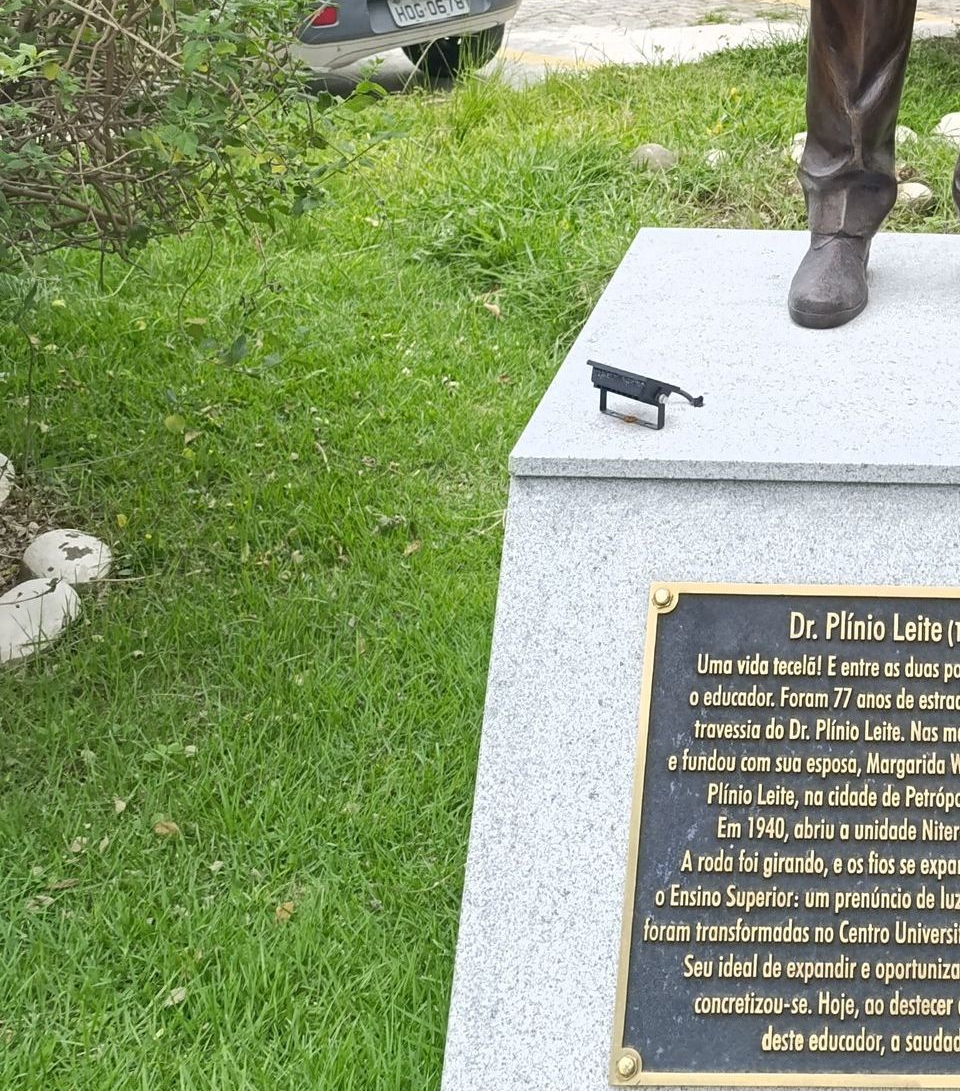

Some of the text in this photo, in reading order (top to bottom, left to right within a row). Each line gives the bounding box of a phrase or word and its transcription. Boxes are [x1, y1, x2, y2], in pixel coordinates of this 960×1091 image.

[790, 611, 818, 639] Dr.
[826, 610, 885, 641] Plínio
[893, 613, 942, 642] Leite
[697, 653, 733, 674] Uma
[737, 653, 769, 675] vida
[773, 654, 822, 676] tecelã!
[827, 655, 836, 676] E
[841, 658, 880, 677] entre
[884, 662, 900, 677] as
[905, 655, 939, 678] duas
[689, 691, 699, 706] o
[703, 684, 775, 707] educador.
[780, 686, 828, 708] Foram
[833, 687, 852, 708] 77
[856, 692, 892, 709] anos
[896, 687, 914, 709] de
[694, 720, 761, 739] travessia
[765, 717, 784, 739] do
[789, 718, 810, 740] Dr.
[816, 718, 859, 741] Plínio
[864, 719, 905, 741] Leite.
[910, 720, 938, 742] Nas
[668, 755, 677, 771] e
[682, 748, 736, 771] fundou
[740, 756, 771, 772] com
[775, 756, 802, 772] sua
[806, 757, 862, 778] esposa,
[866, 751, 945, 779] Margarida
[708, 782, 753, 805] Plínio
[757, 783, 799, 809] Leite,
[804, 790, 823, 806] na
[828, 784, 877, 806] cidade
[881, 784, 901, 807] de
[717, 815, 741, 838] Em
[748, 816, 789, 843] 1940,
[794, 816, 835, 839] abriu
[840, 824, 849, 840] a
[855, 817, 917, 840] unidade
[680, 849, 692, 871] A
[698, 850, 733, 872] roda
[738, 848, 759, 872] foi
[763, 849, 828, 878] girando,
[833, 857, 843, 873] e
[847, 858, 863, 873] os
[868, 850, 895, 874] fios
[900, 858, 915, 874] se
[655, 890, 665, 906] o
[670, 884, 721, 907] Ensino
[726, 884, 799, 912] Superior:
[805, 891, 829, 908] um
[835, 886, 912, 913] prenúncio
[916, 886, 935, 909] de
[644, 917, 690, 942] foram
[696, 917, 810, 943] transformadas
[815, 926, 834, 943] no
[839, 920, 890, 943] Centro
[683, 954, 713, 977] Seu
[718, 954, 758, 977] ideal
[762, 953, 782, 978] de
[786, 954, 857, 983] expandir
[861, 962, 870, 979] e
[694, 992, 812, 1014] concretizou-se.
[818, 991, 859, 1020] Hoje,
[865, 998, 884, 1015] ao
[889, 991, 954, 1016] destecer
[761, 1024, 804, 1051] deste
[809, 1026, 885, 1056] educador,
[891, 1034, 900, 1052] a
